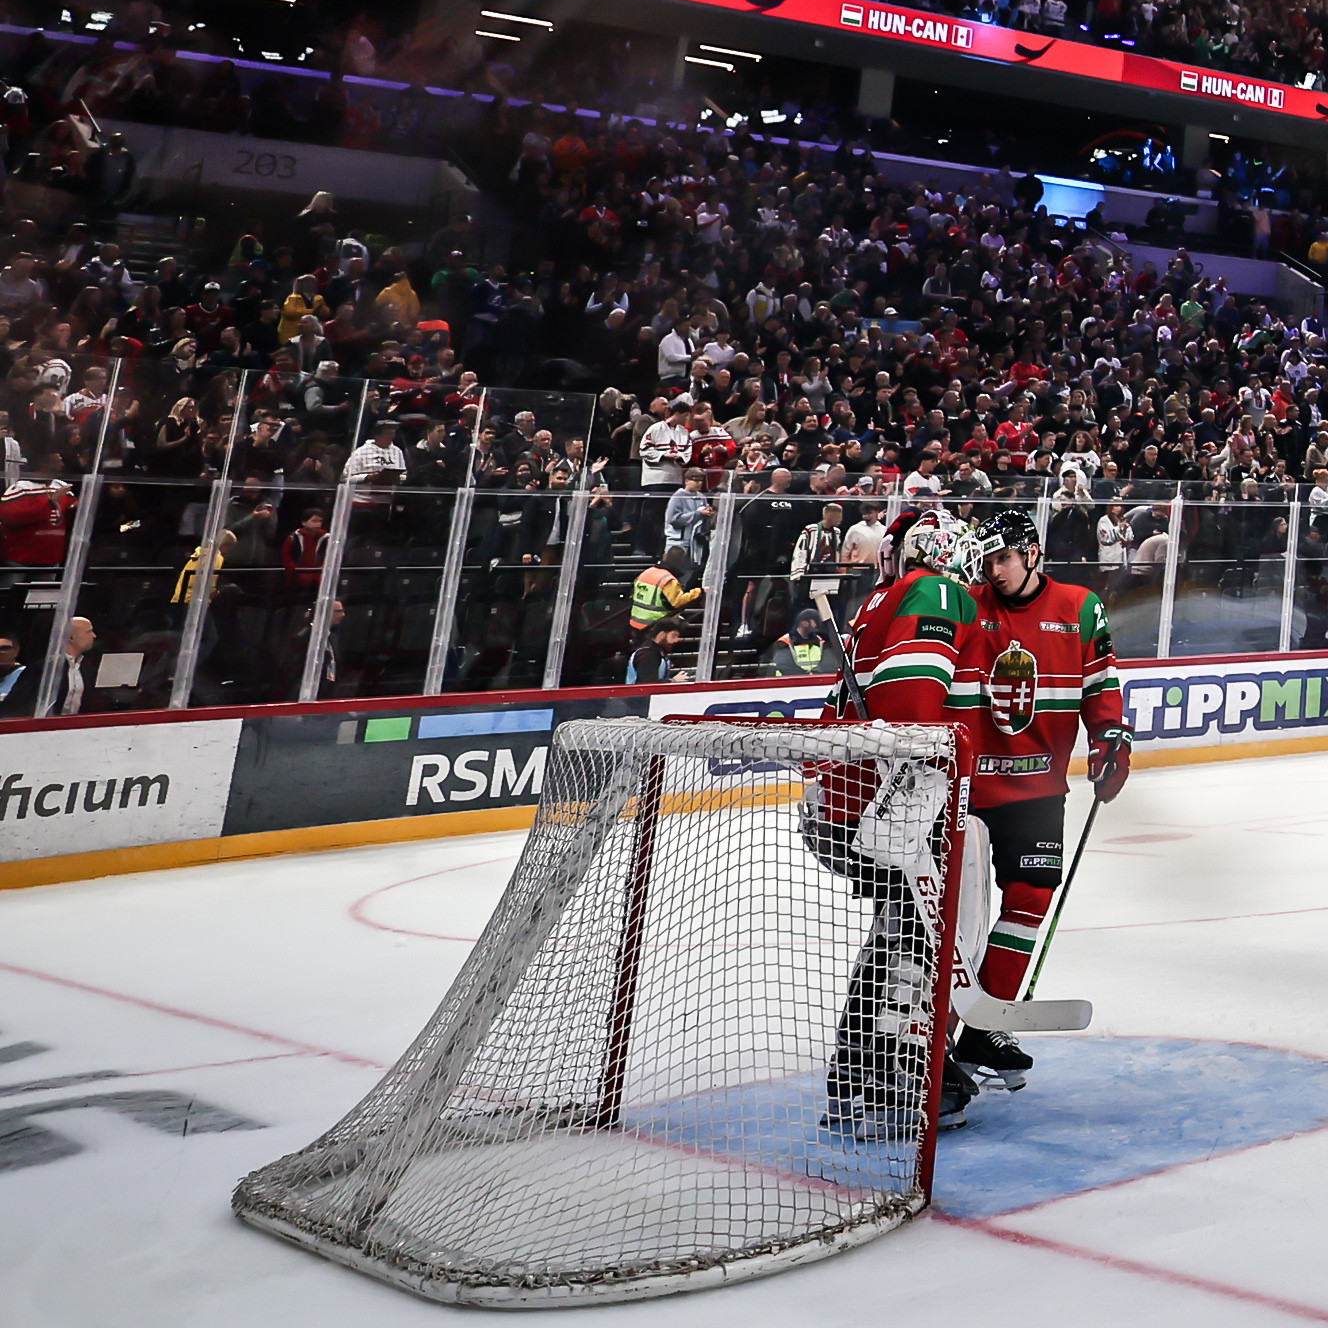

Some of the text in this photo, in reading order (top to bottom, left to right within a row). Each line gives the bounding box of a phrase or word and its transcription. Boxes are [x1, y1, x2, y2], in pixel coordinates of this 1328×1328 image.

[867, 11, 949, 46] HUN-CAN
[1201, 75, 1266, 105] HUN-CAN
[232, 149, 299, 180] 203
[938, 583, 948, 610] 1
[406, 746, 549, 806] RSM
[957, 779, 971, 830] ICEPRO
